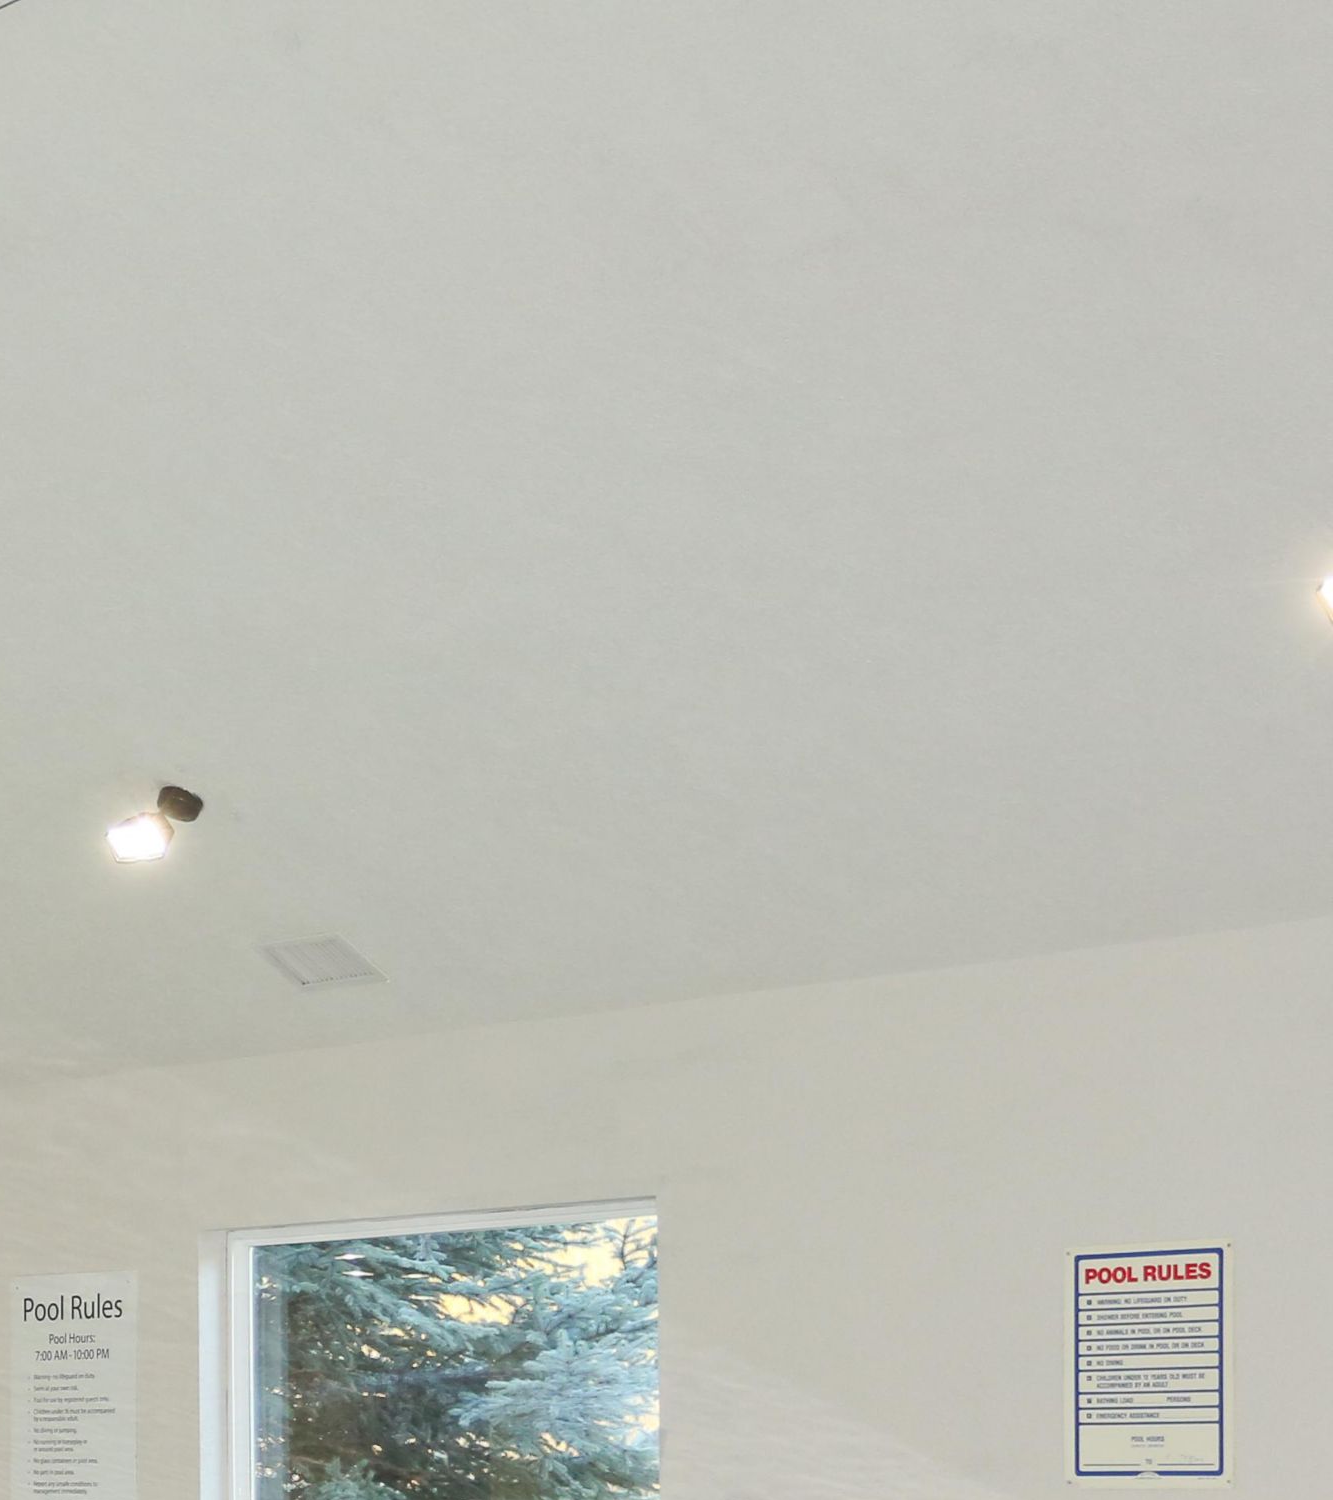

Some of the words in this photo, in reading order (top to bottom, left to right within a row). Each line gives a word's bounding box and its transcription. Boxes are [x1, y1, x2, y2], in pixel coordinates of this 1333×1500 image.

[1085, 1267, 1138, 1284] POOL
[1143, 1262, 1211, 1281] RULES
[24, 1295, 64, 1321] Pool
[72, 1293, 123, 1319] Rules
[49, 1333, 67, 1344] Pool
[69, 1333, 95, 1343] Hours:
[35, 1351, 52, 1361] 7:00
[54, 1350, 67, 1360] AM
[97, 1349, 109, 1359] PM
